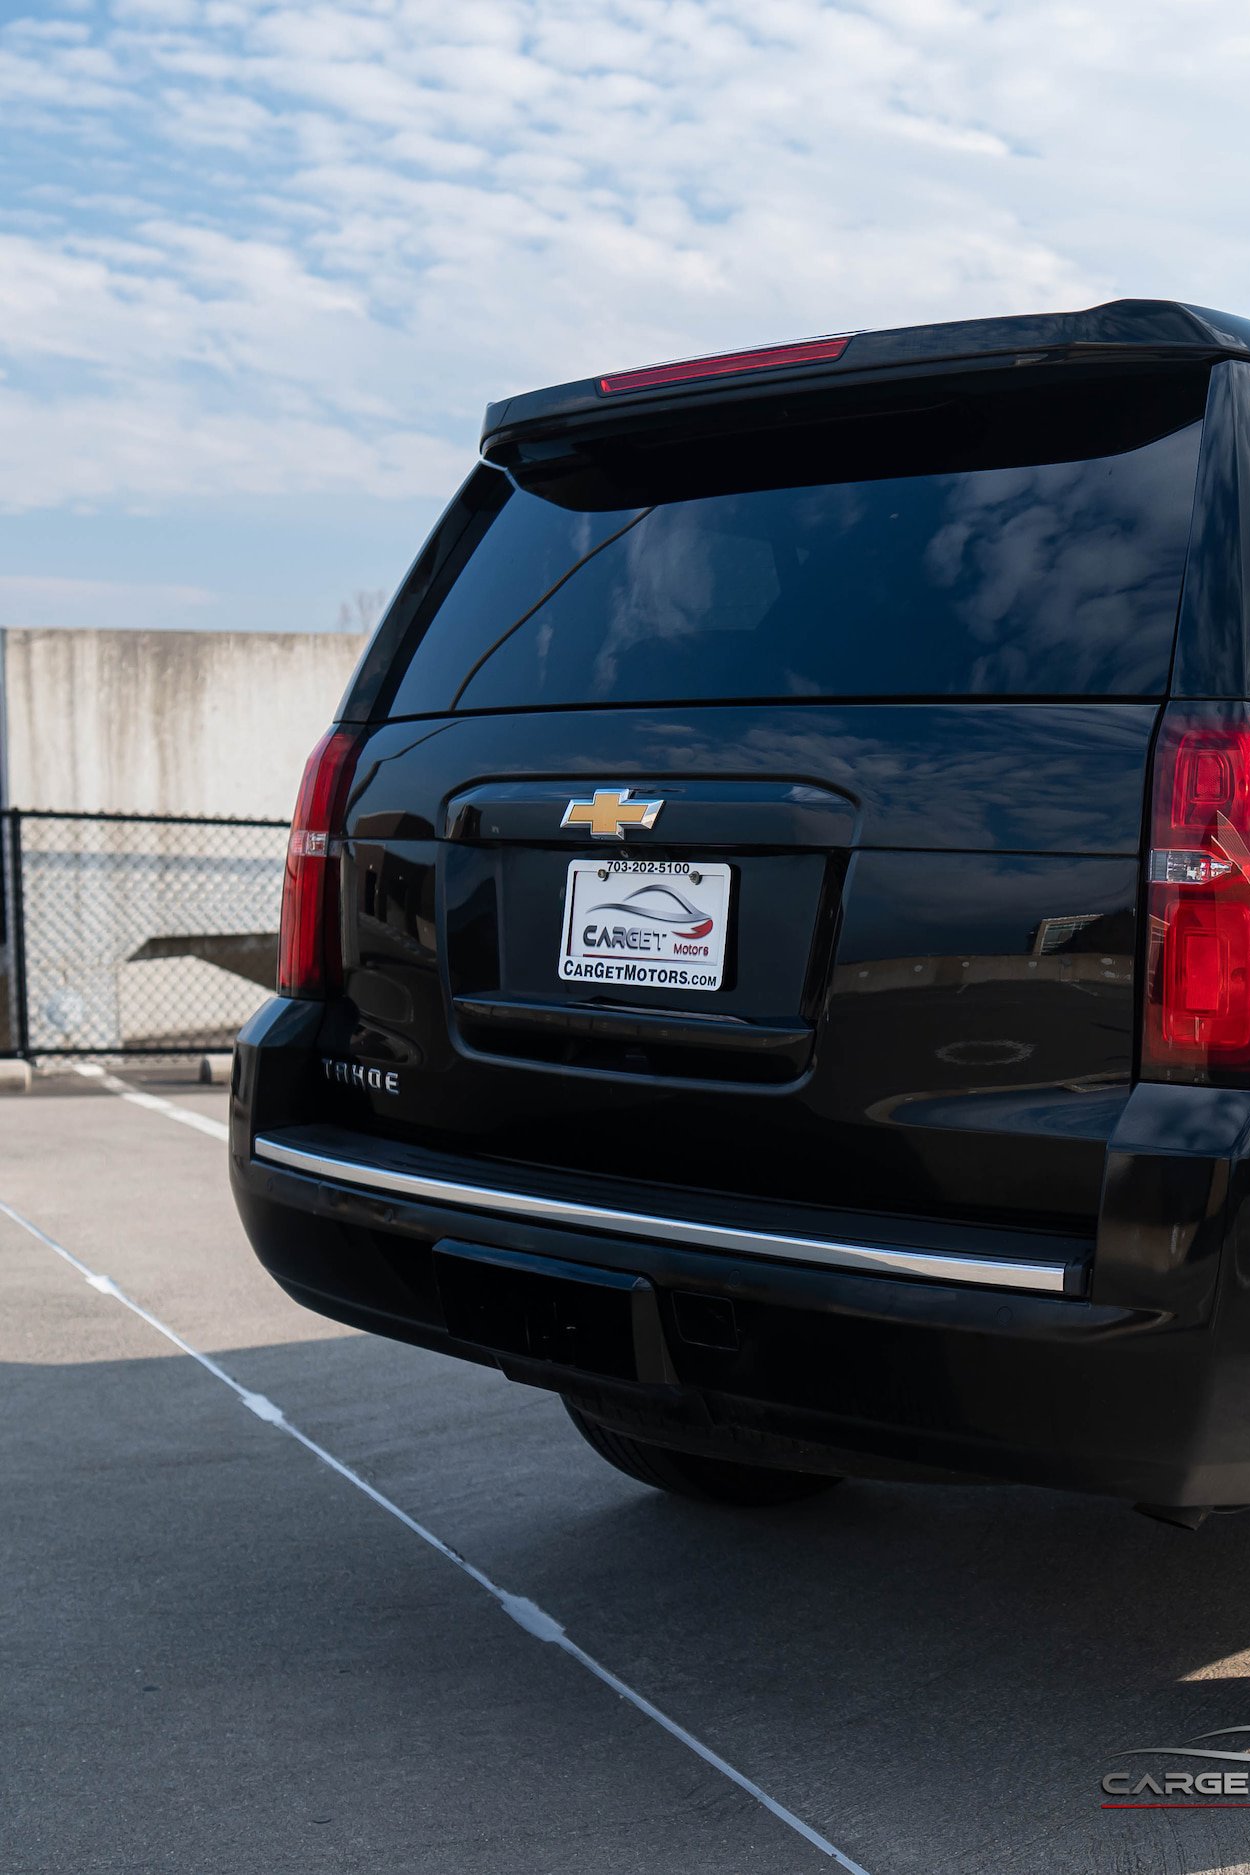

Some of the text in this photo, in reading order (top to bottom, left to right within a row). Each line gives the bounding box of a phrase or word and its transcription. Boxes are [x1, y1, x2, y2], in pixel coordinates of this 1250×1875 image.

[606, 861, 690, 874] 703-202-5100
[582, 925, 709, 957] CARGET Motors
[321, 1057, 400, 1096] TAHOE
